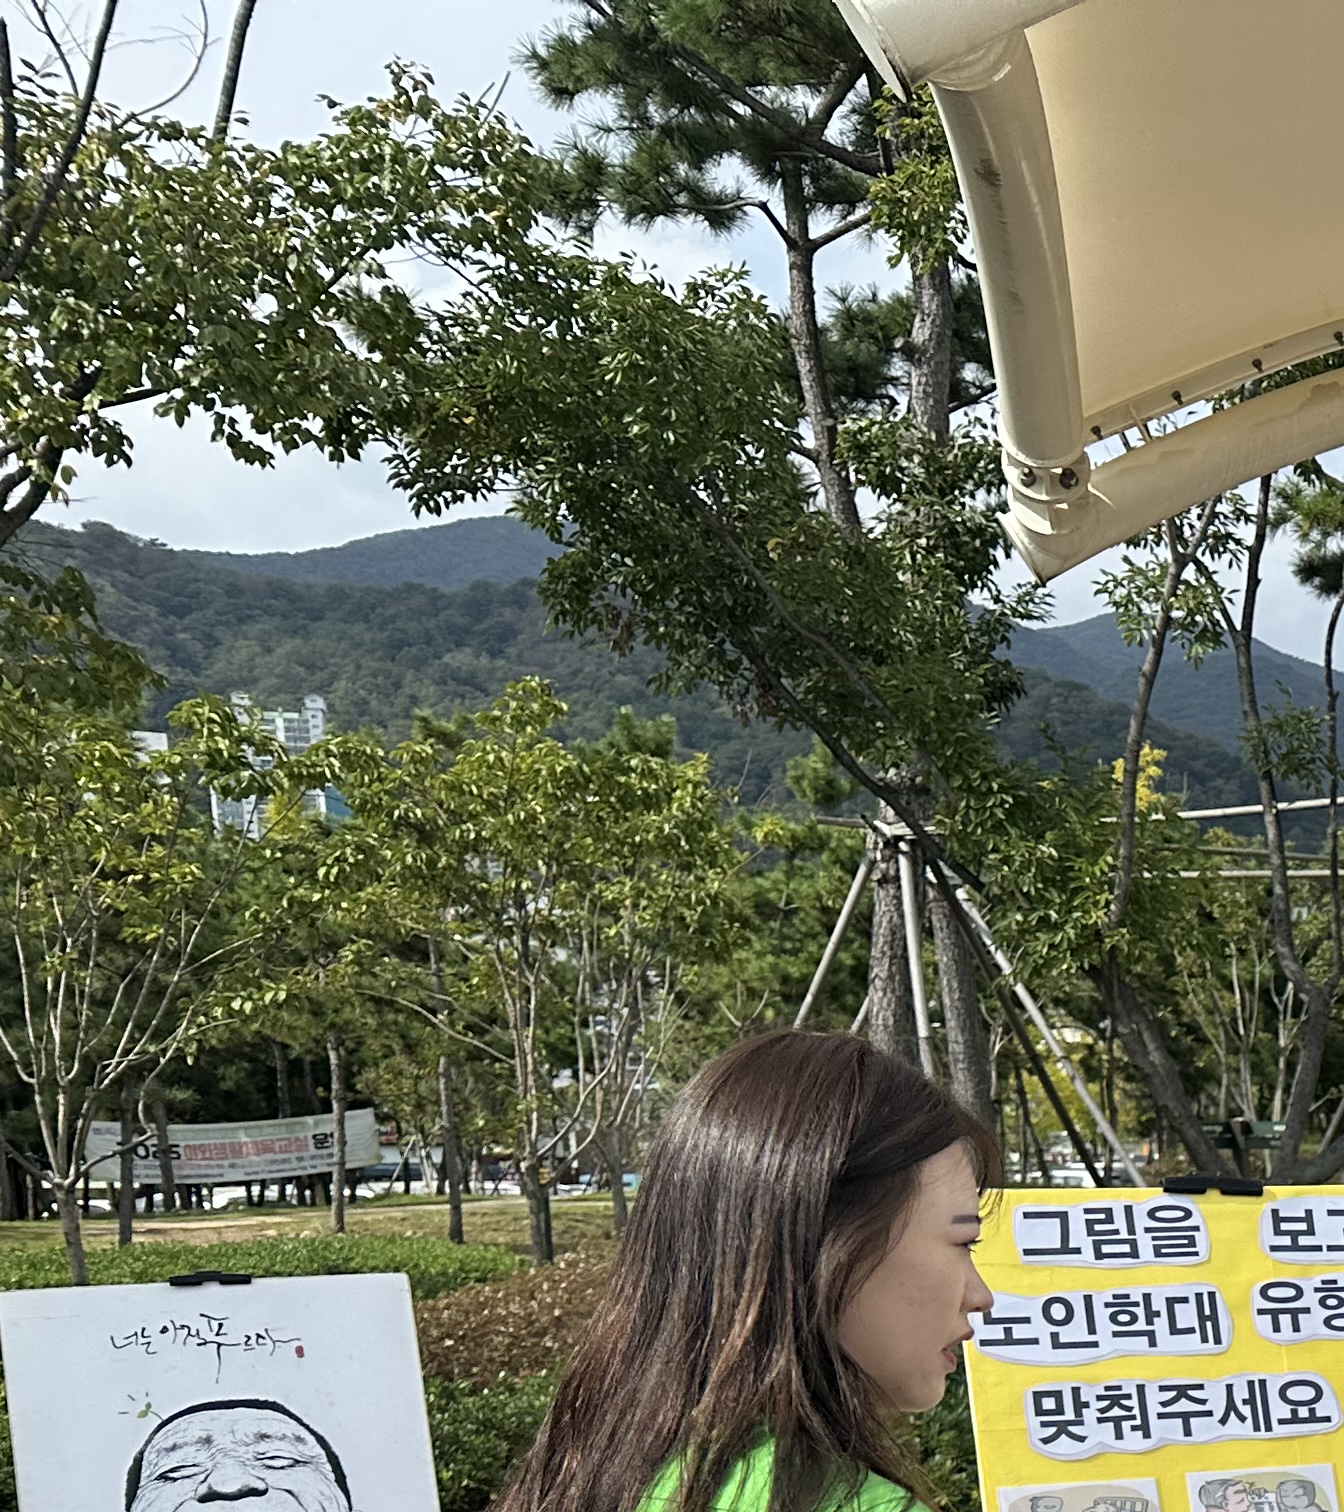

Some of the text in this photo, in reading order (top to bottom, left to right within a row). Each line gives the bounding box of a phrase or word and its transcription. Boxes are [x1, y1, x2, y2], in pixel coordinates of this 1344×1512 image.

[1021, 1203, 1201, 1261] 그림을
[110, 1313, 302, 1385] 너는 아직 푸르다
[979, 1289, 1223, 1351] 노인학대
[1032, 1377, 1333, 1448] 맞춰주세요
